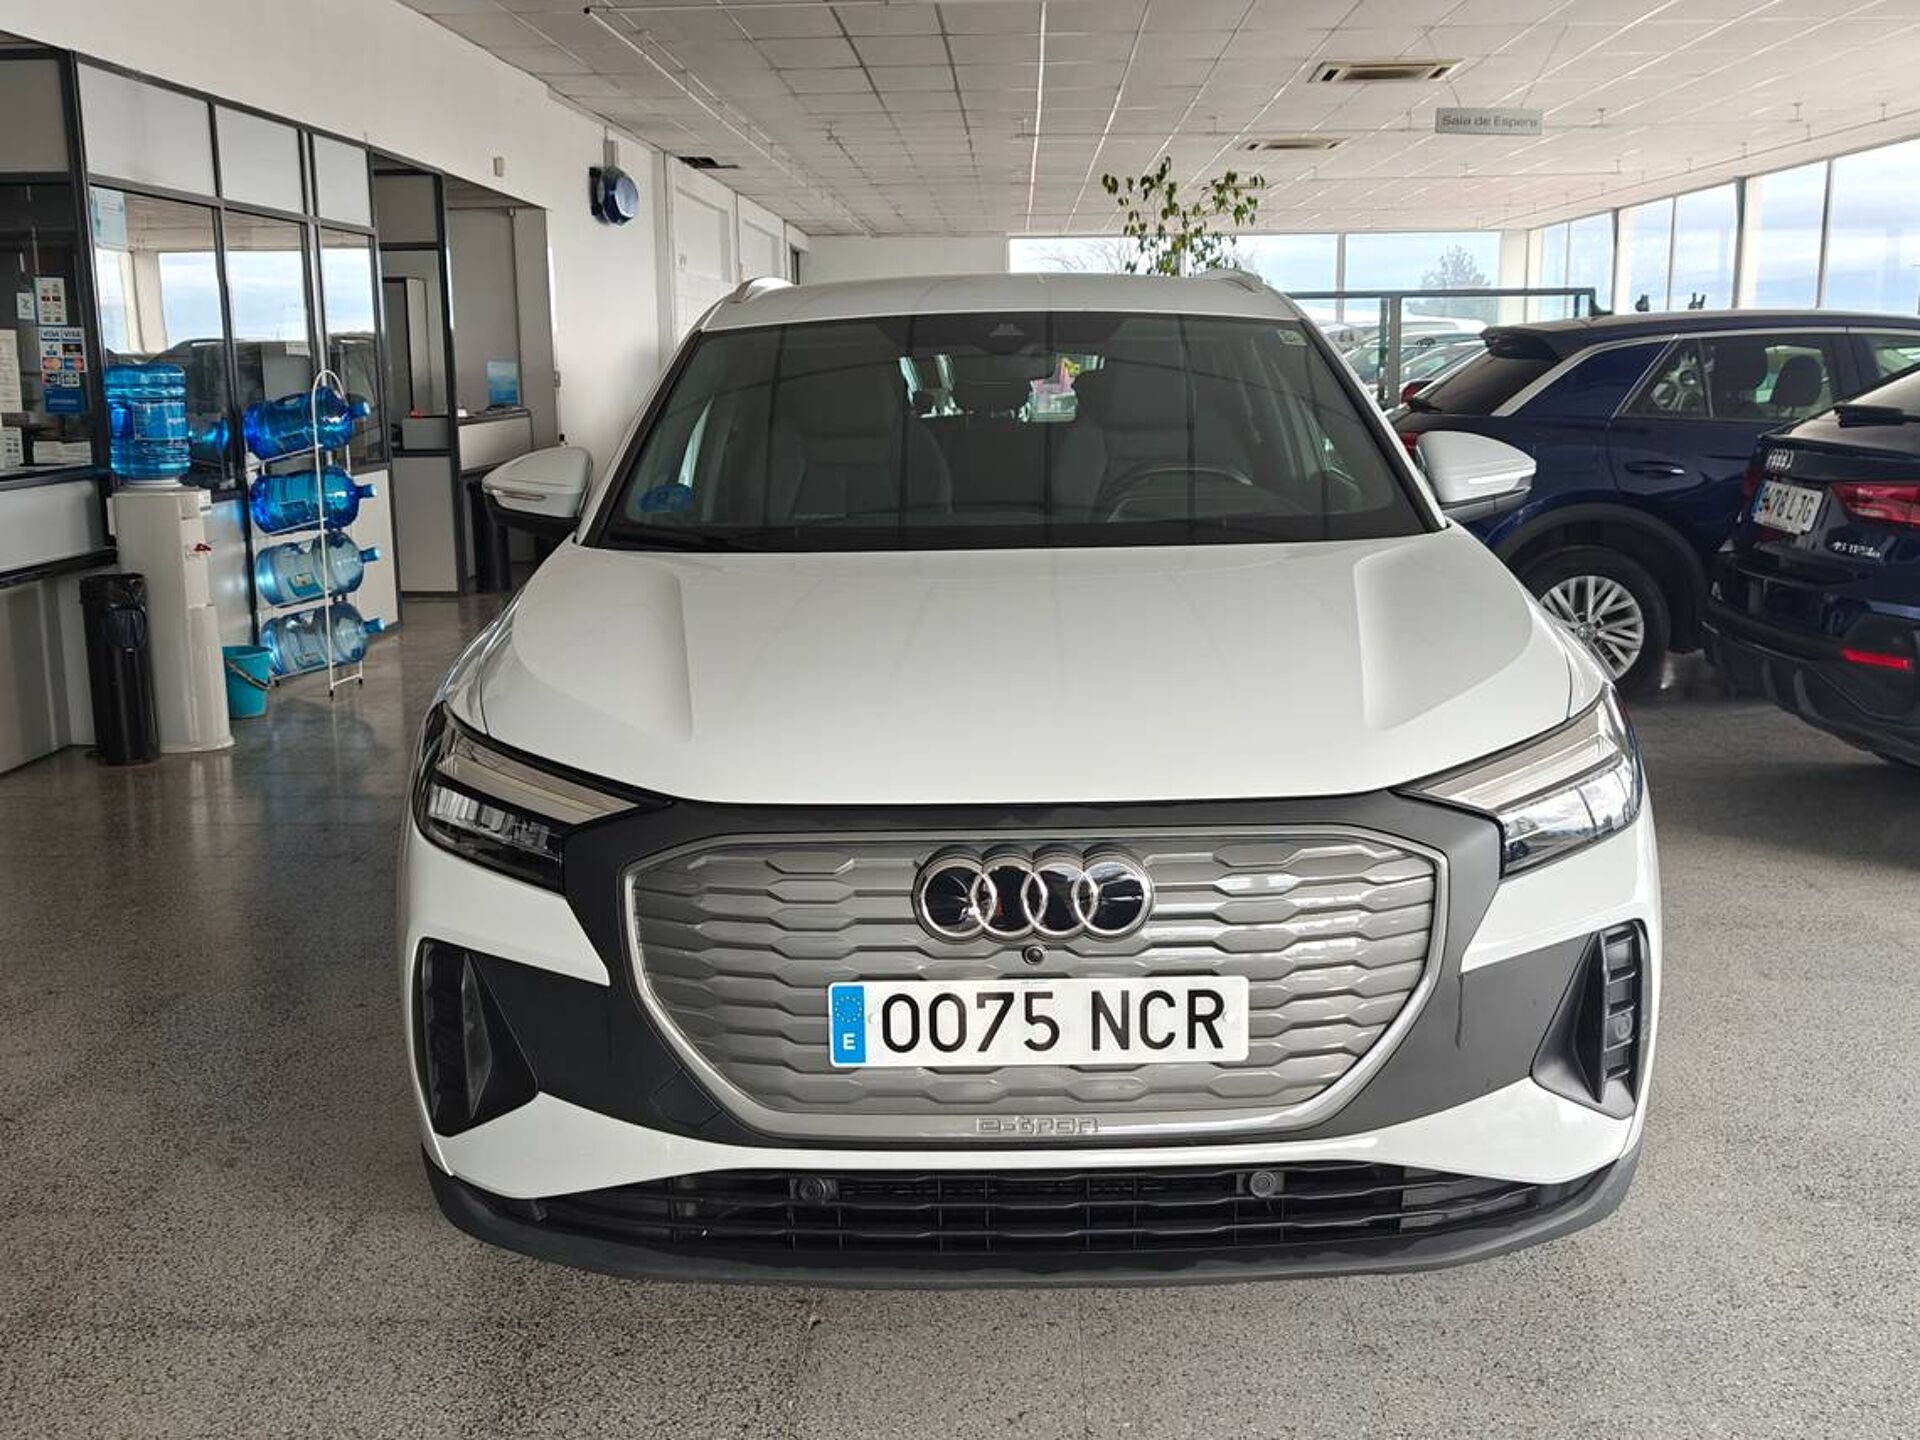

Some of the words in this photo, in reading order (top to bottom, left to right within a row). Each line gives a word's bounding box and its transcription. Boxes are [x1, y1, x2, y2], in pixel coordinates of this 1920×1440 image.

[1442, 115, 1470, 126] Sala
[1474, 115, 1489, 126] de
[1494, 115, 1538, 128] Espera
[843, 1033, 856, 1050] E
[882, 991, 1060, 1053] 0075
[1091, 989, 1224, 1051] NCR
[977, 1116, 1101, 1135] e-tron
